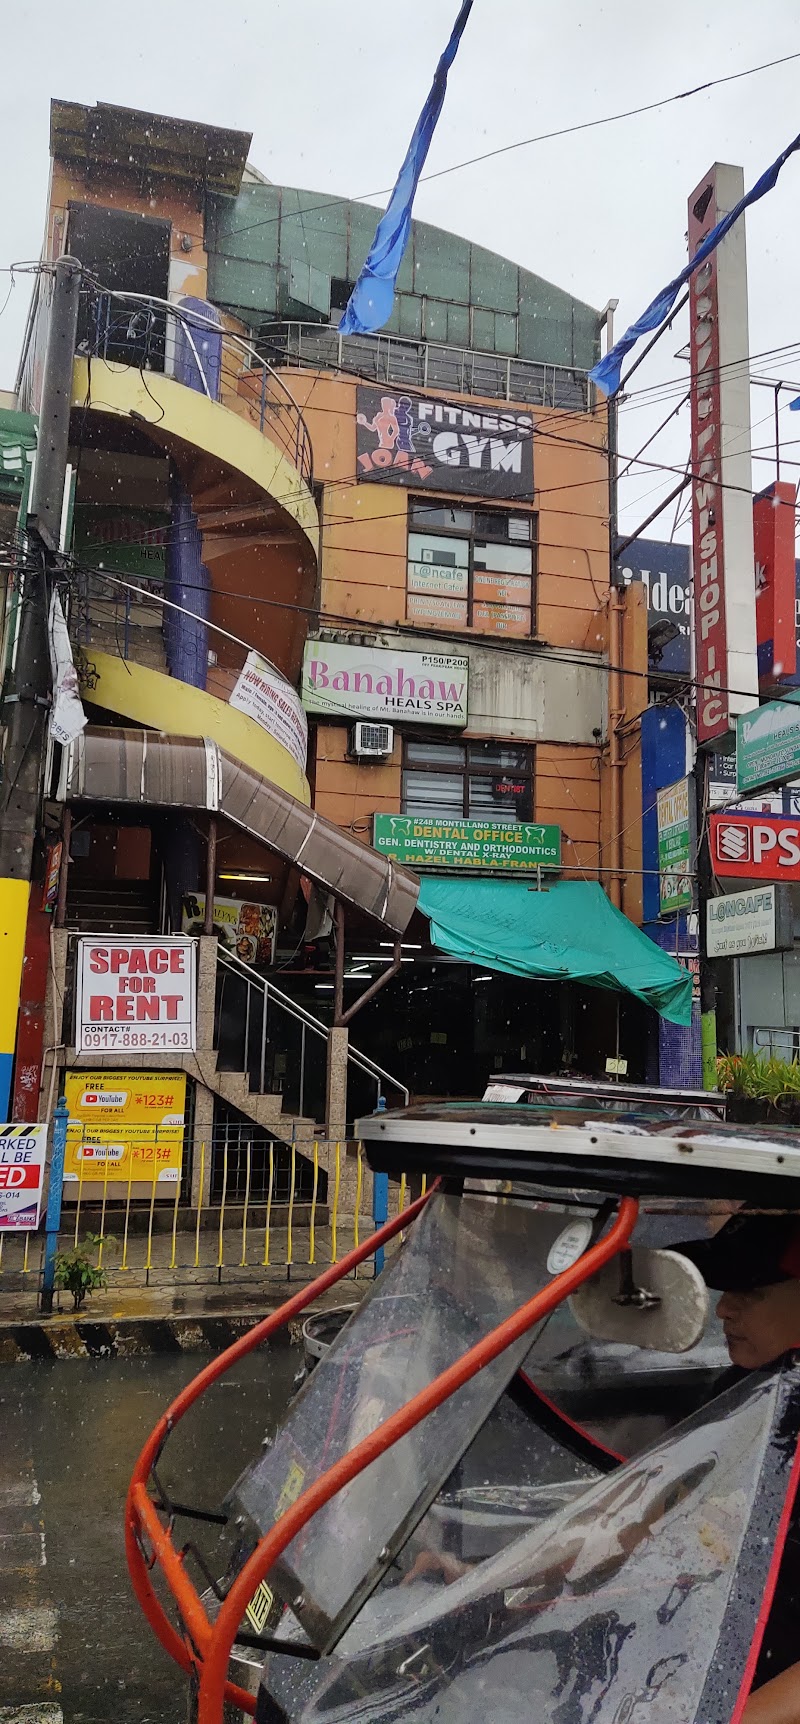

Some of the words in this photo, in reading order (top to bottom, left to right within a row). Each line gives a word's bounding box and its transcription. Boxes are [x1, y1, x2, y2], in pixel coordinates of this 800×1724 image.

[418, 403, 533, 434] FITNESS
[433, 432, 523, 473] GYM
[357, 449, 434, 480] JOAN
[411, 579, 441, 589] Internet
[422, 655, 469, 667] P150/P200
[309, 660, 465, 702] Banahaw
[236, 692, 254, 705] Apply
[244, 669, 262, 687] NOW
[277, 696, 292, 718] SALES
[348, 702, 371, 711] healing
[392, 707, 420, 715] Banahaw
[447, 712, 465, 720] hands.
[385, 697, 432, 710] HEALS
[436, 702, 464, 713] SPA
[435, 820, 489, 829] MONTILLANO
[491, 823, 523, 831] STREET
[414, 826, 468, 839] DENTAL
[473, 829, 523, 843] OFFICE
[378, 837, 401, 846] GEN.
[404, 839, 458, 849] DENTISTRY
[461, 841, 480, 851] AND
[483, 844, 557, 856] ORTHODONTICS
[439, 849, 479, 857] DENTAL
[752, 825, 800, 867] PS
[405, 854, 449, 864] HAZEL
[709, 892, 772, 922] L@NCAFE
[89, 948, 185, 974] SPACE
[118, 976, 156, 994] FOR
[89, 995, 183, 1021] RENT
[84, 1032, 189, 1047] 0917-888-21-03
[98, 1095, 123, 1103] YouTube
[82, 1136, 102, 1144] FREE
[14, 1152, 33, 1163] BE
